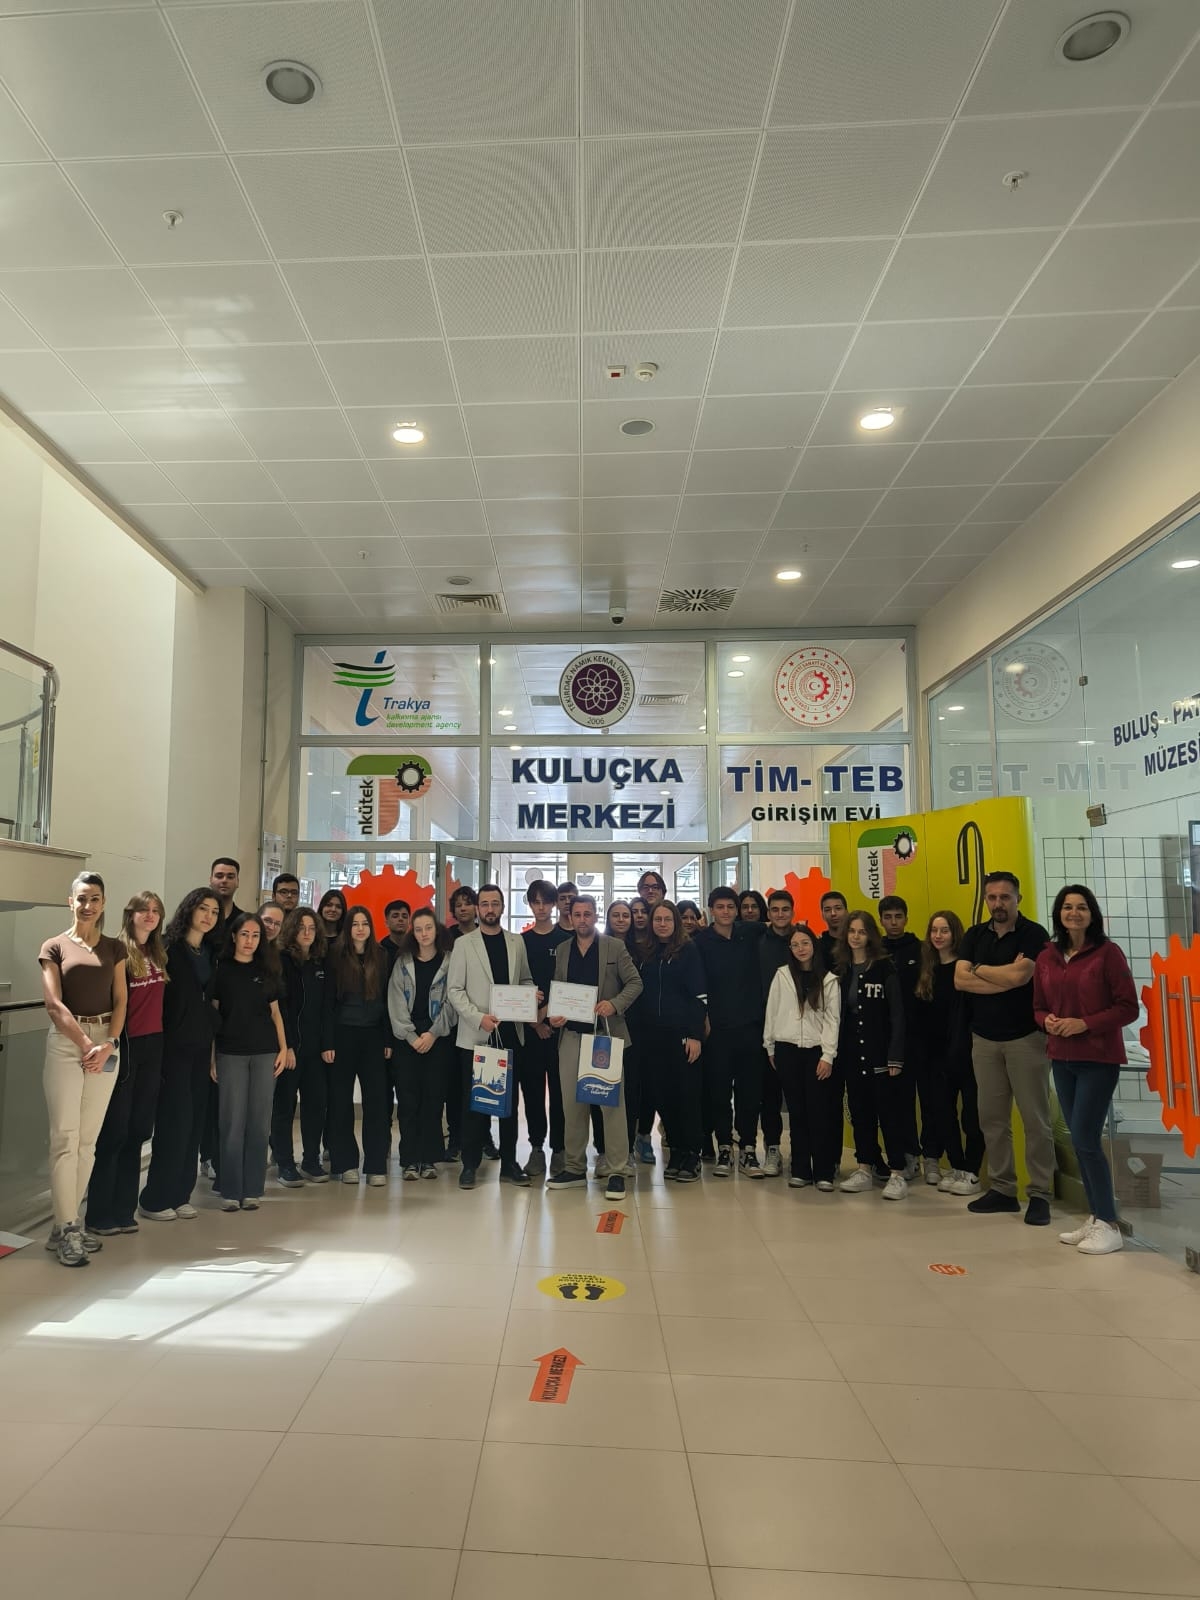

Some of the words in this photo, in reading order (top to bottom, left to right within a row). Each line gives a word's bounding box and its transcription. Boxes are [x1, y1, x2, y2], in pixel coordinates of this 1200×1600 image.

[570, 656, 593, 675] NAMIK
[593, 655, 617, 668] KEMAL
[383, 697, 431, 713] Trakya
[435, 722, 462, 730] agency
[1113, 710, 1160, 747] BULUŞ
[512, 758, 684, 790] KULUÇKA
[727, 760, 812, 792] TİM-
[824, 766, 903, 792] TEB
[358, 779, 374, 835] nkütek
[518, 798, 675, 829] MERKEZİ
[751, 803, 837, 825] GİRİŞİM
[845, 803, 881, 822] EVİ
[866, 849, 880, 899] nkütek
